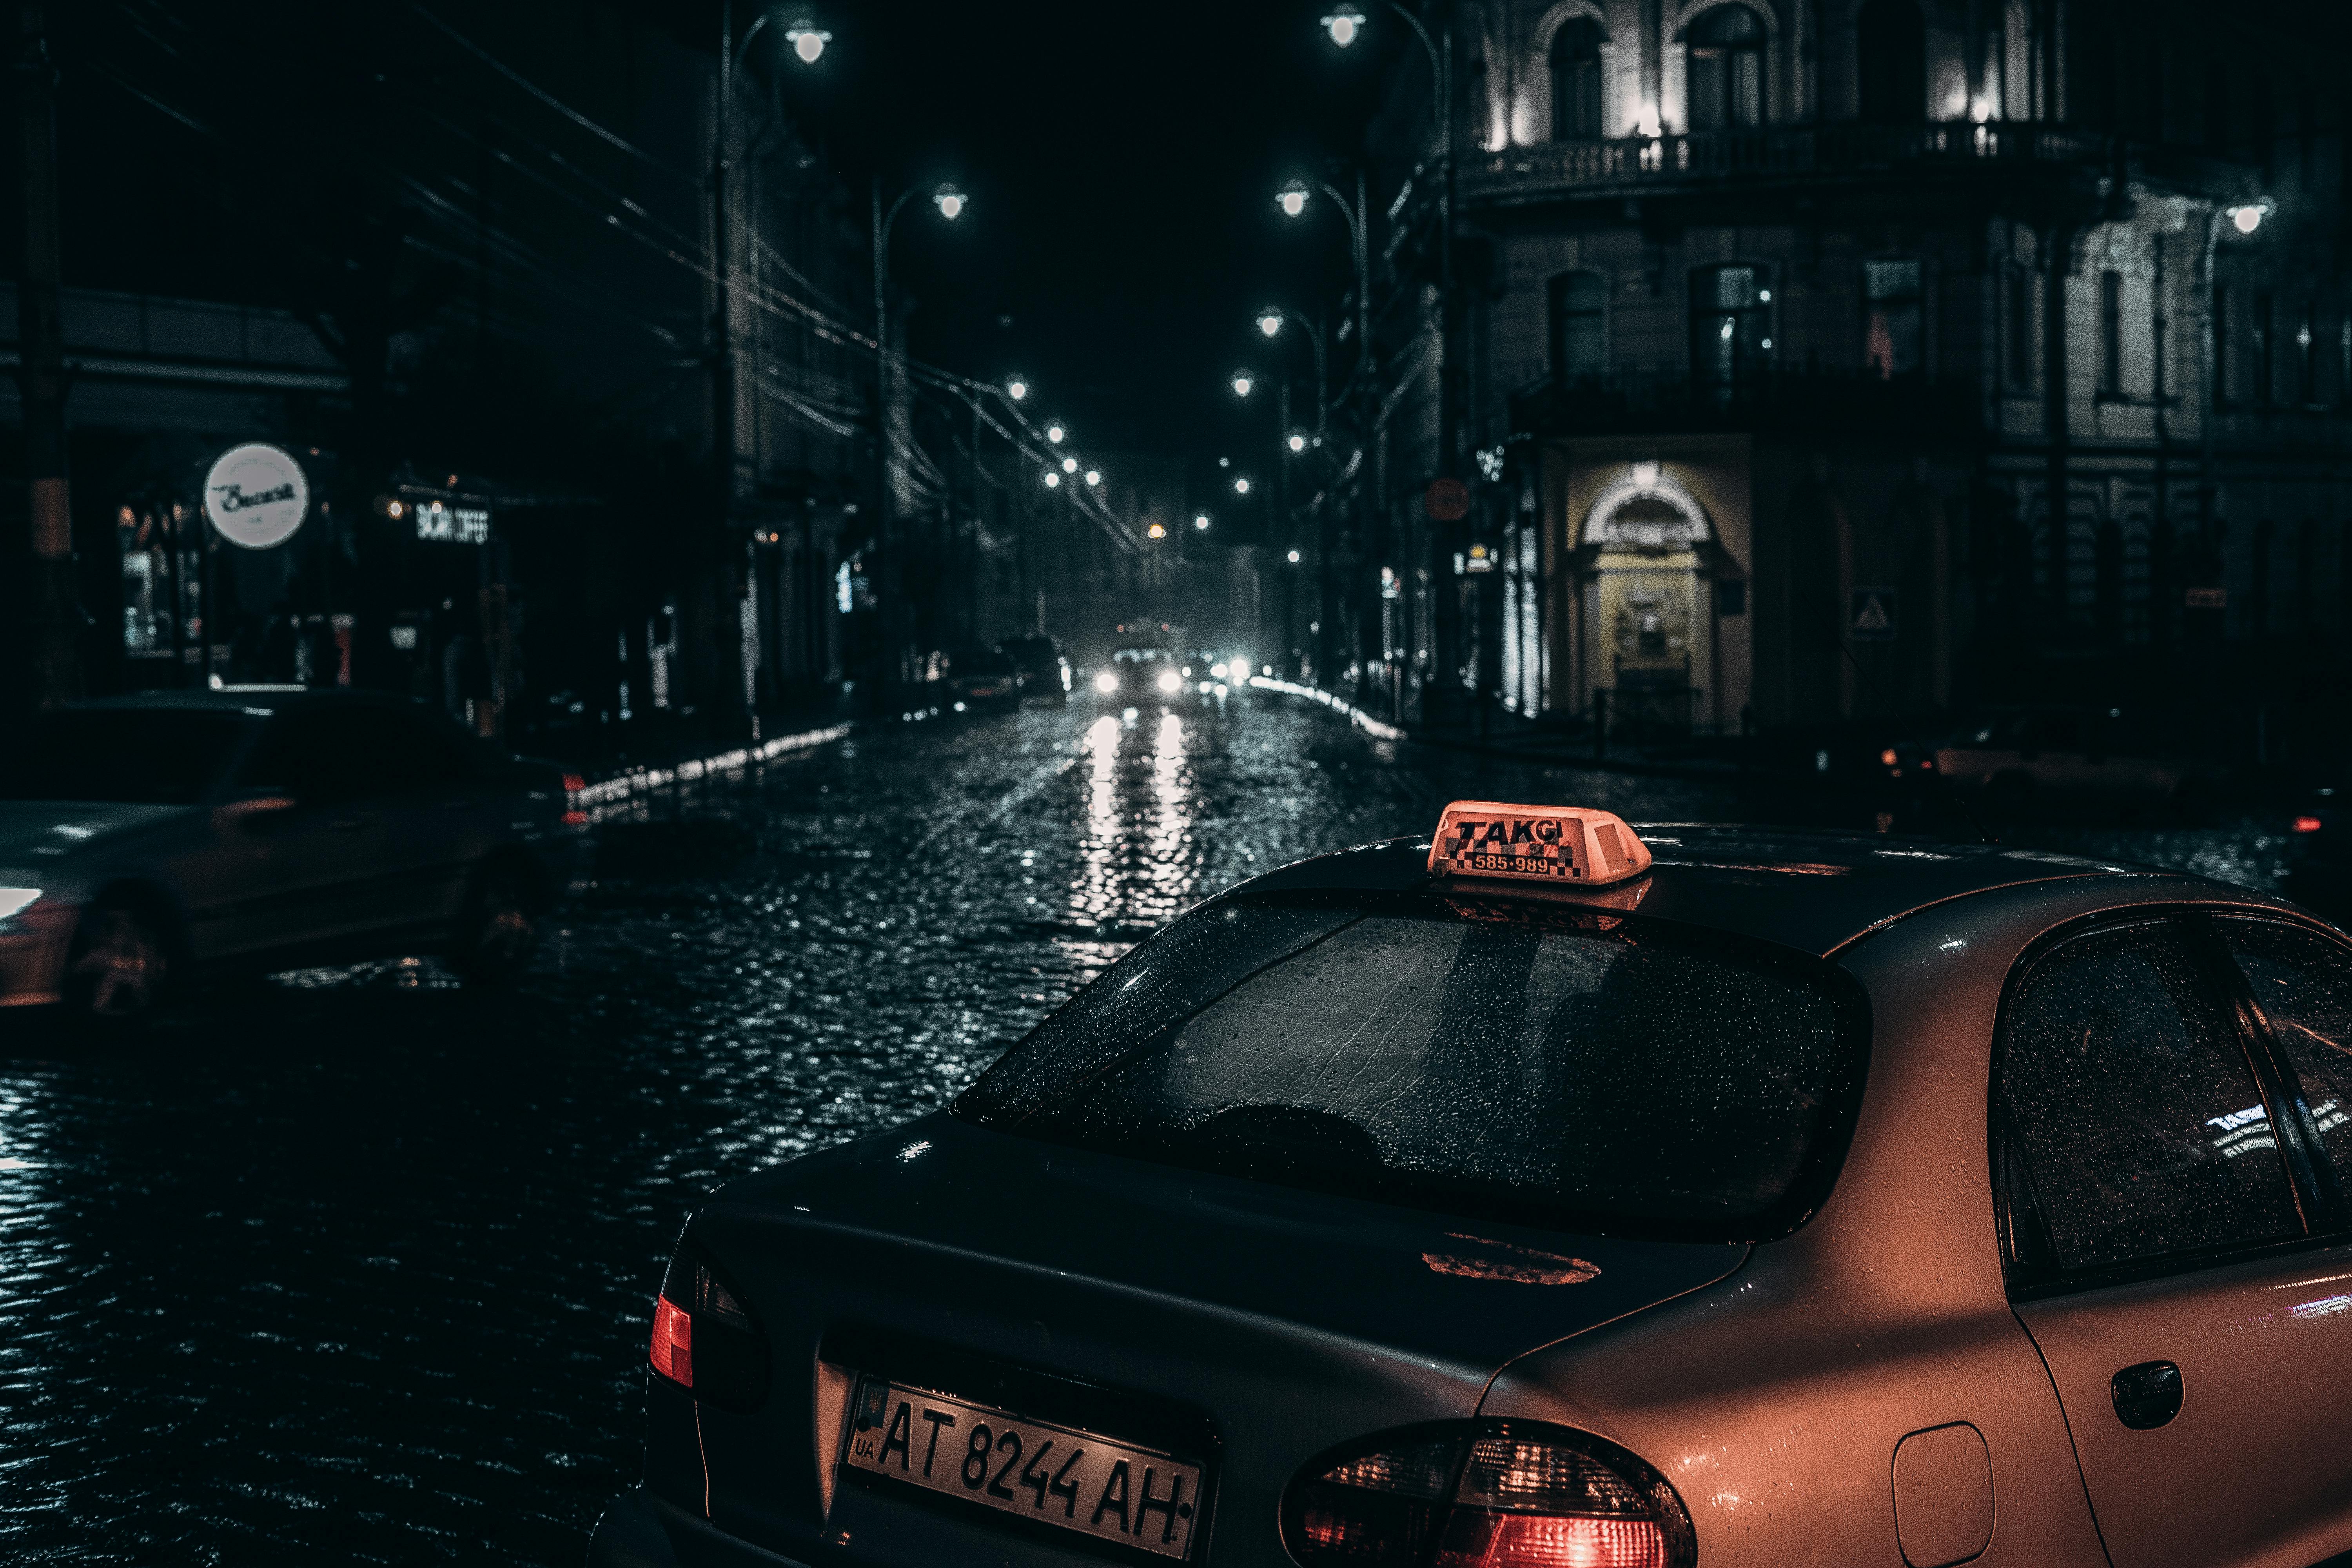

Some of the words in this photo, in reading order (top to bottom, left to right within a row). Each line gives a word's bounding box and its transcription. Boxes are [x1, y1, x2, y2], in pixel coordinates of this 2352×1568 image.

[855, 1437, 874, 1460] UA
[878, 1401, 956, 1477] AT
[961, 1423, 1086, 1518] 8244
[1091, 1457, 1183, 1544] AH
